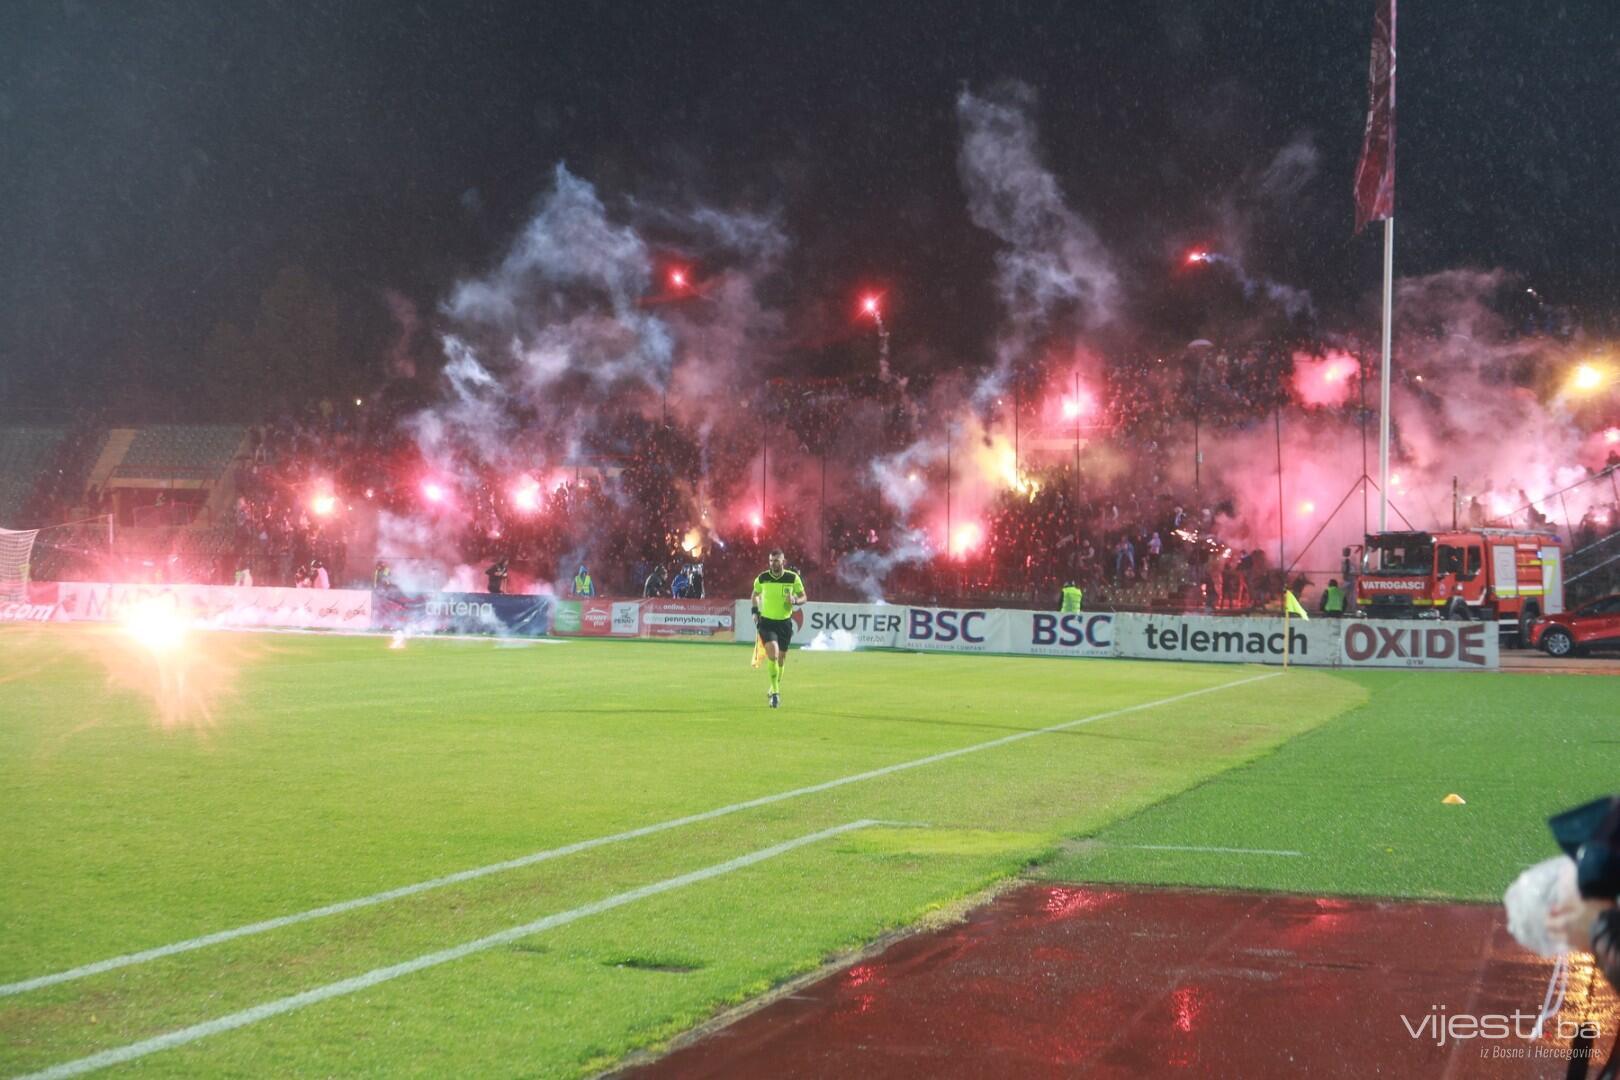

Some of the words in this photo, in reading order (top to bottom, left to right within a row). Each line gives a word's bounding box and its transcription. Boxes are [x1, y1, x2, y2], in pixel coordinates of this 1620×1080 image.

[1362, 581, 1425, 590] VATROGASCI
[425, 600, 493, 617] antena
[810, 612, 902, 632] SKUTER
[908, 609, 986, 643] BSC
[1032, 613, 1112, 647] BSC
[1144, 623, 1308, 655] telemach
[1345, 623, 1486, 665] OXIDE
